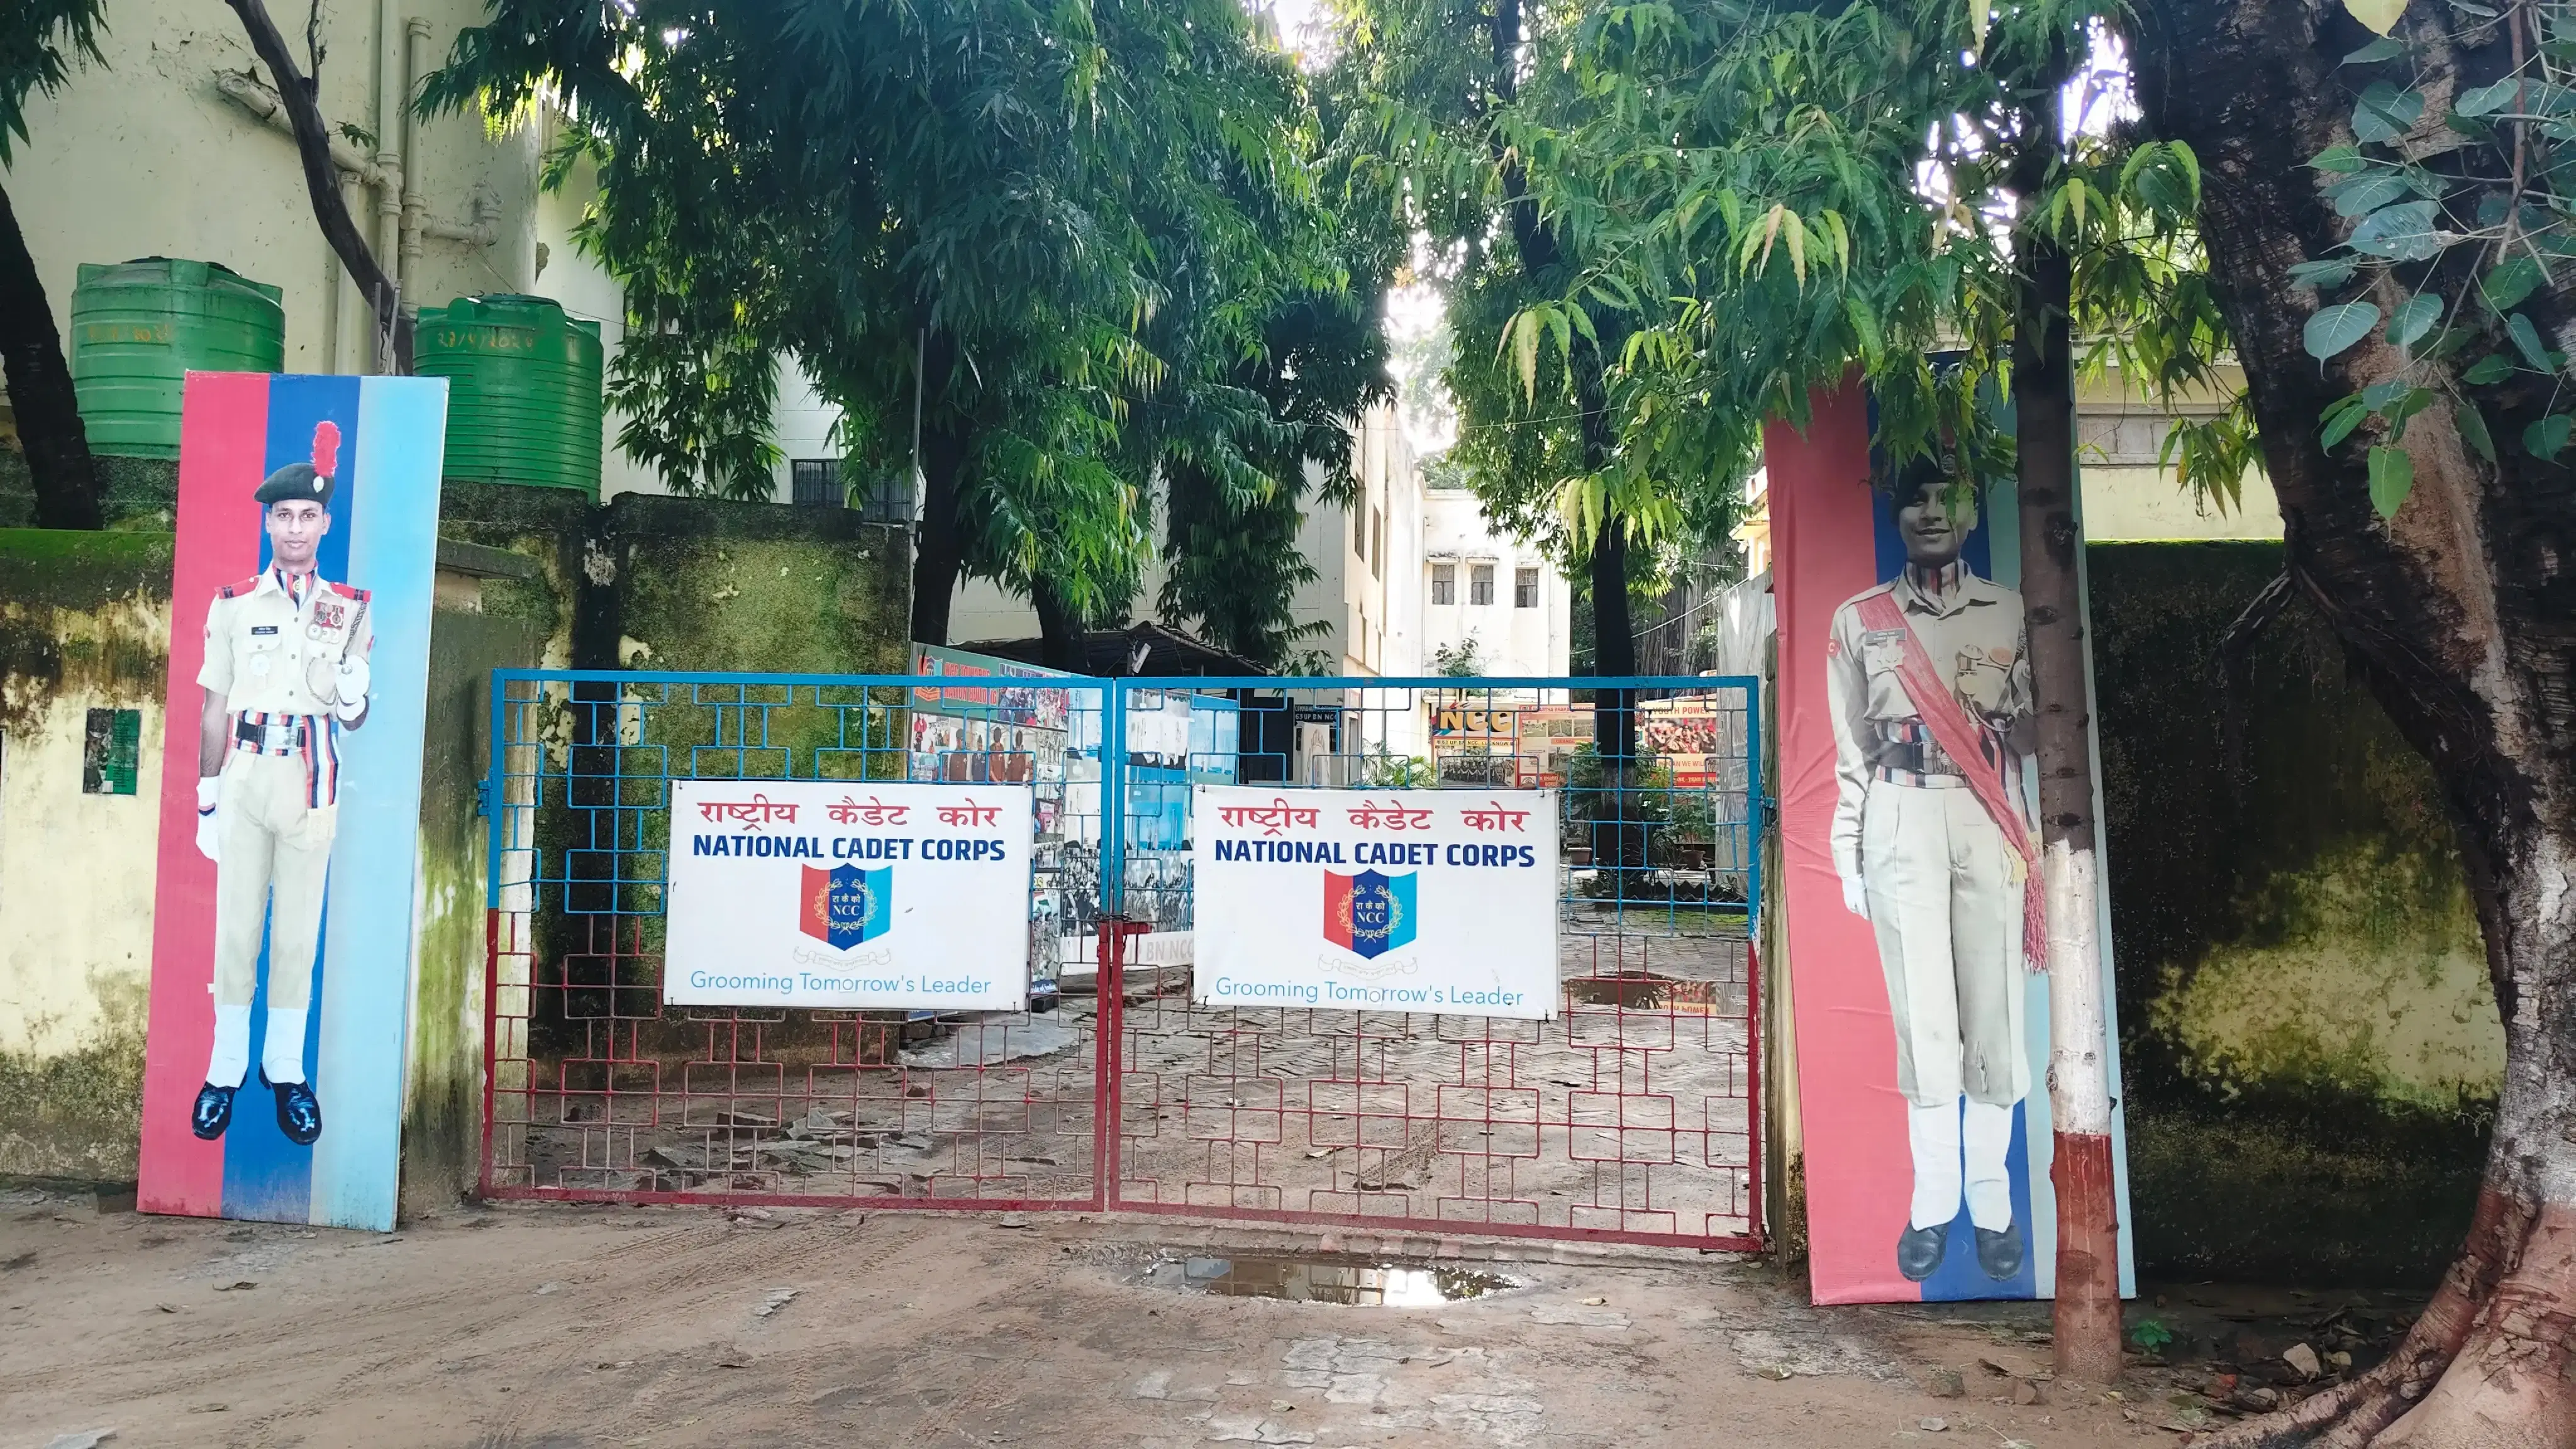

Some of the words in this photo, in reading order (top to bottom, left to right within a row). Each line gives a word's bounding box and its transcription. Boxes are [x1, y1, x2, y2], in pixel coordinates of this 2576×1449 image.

[1436, 706, 1513, 732] NCC
[1682, 706, 1710, 714] POWER
[696, 794, 800, 831] राष्ट्रीय
[825, 796, 911, 826] कैडेट
[935, 798, 1003, 828] कोर
[1217, 797, 1321, 836] राष्ट्रीय
[1345, 799, 1434, 830] कैडेट
[1460, 801, 1531, 832] कोर
[694, 835, 824, 858] NATIONAL
[832, 837, 913, 860] CADET
[921, 839, 1006, 862] CORPS
[1215, 840, 1346, 864] NATIONAL
[1354, 842, 1438, 866] CADET
[1446, 844, 1535, 868] CORPS
[832, 904, 860, 916] NCC
[1357, 912, 1385, 923] NCC
[1145, 940, 1164, 961] BN
[690, 970, 793, 995] Grooming
[799, 973, 915, 994] Tomorrow's
[921, 975, 992, 994] Leader
[1216, 977, 1318, 1003] Grooming
[1324, 980, 1443, 1004] Tomorrow's
[1451, 982, 1524, 1006] Leader
